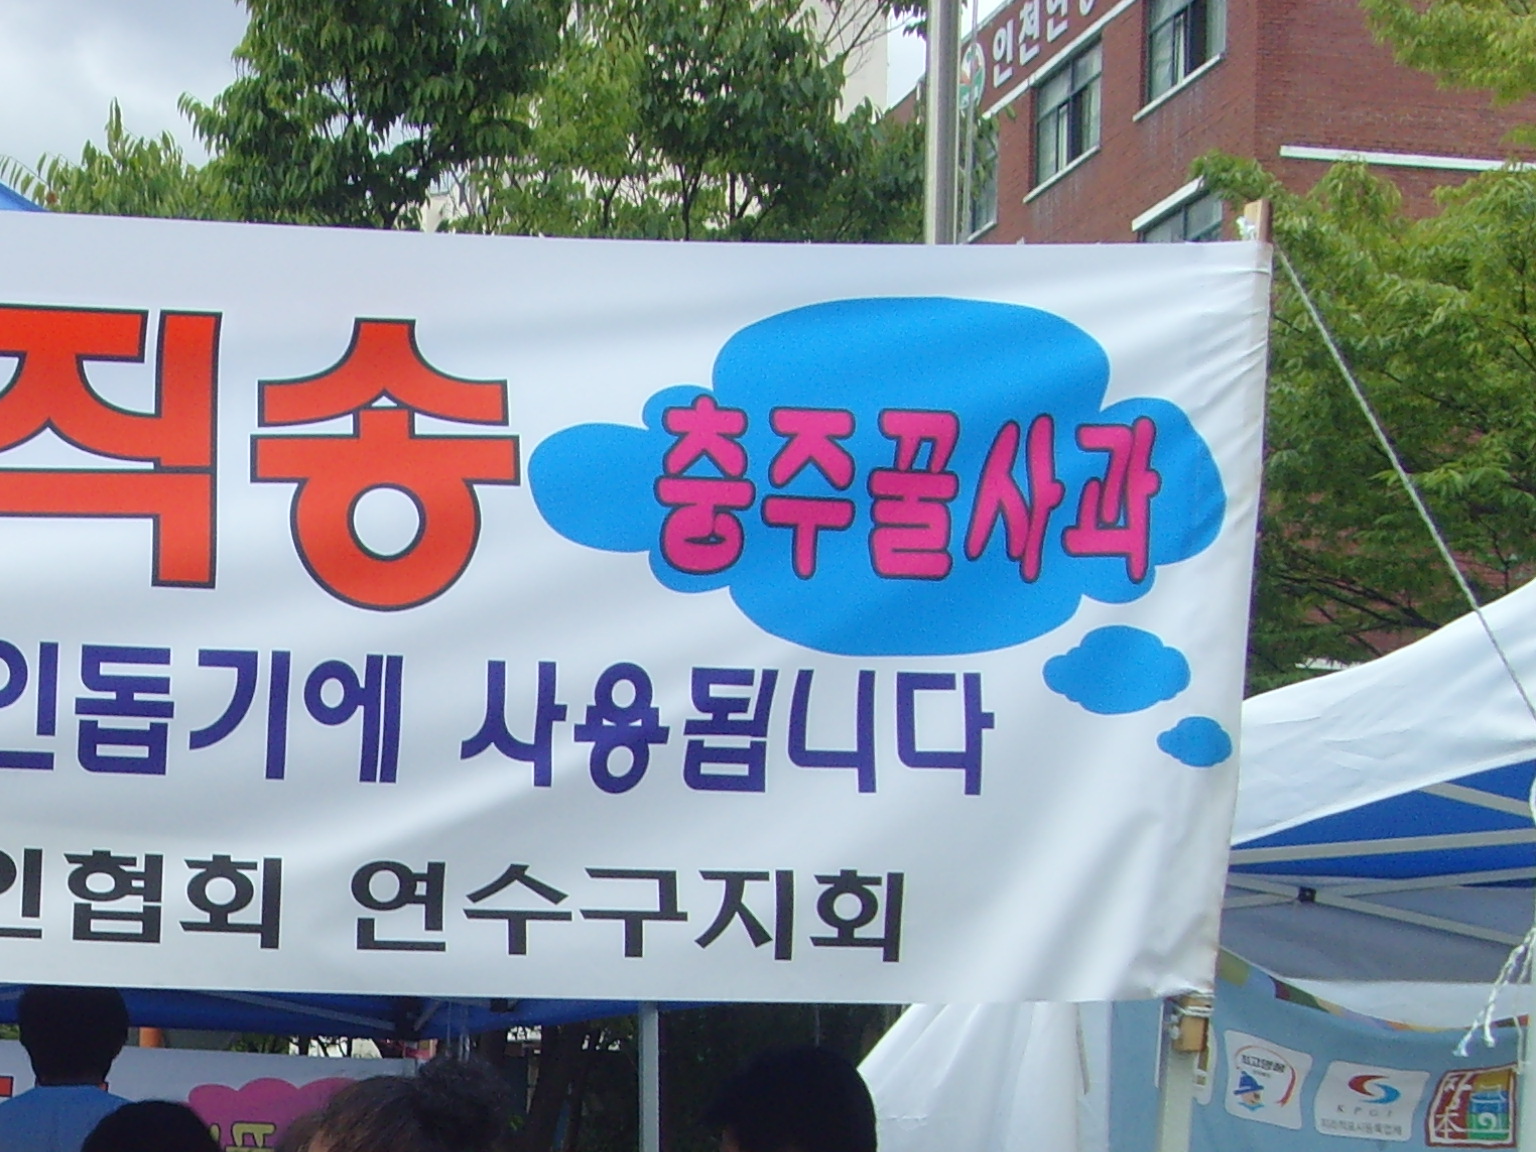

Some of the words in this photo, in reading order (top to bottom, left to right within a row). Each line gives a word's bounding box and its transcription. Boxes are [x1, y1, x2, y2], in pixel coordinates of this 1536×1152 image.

[652, 393, 1162, 584] 충주꿀사과
[461, 660, 995, 796] 사용됩니다
[349, 859, 904, 962] 연수구지회
